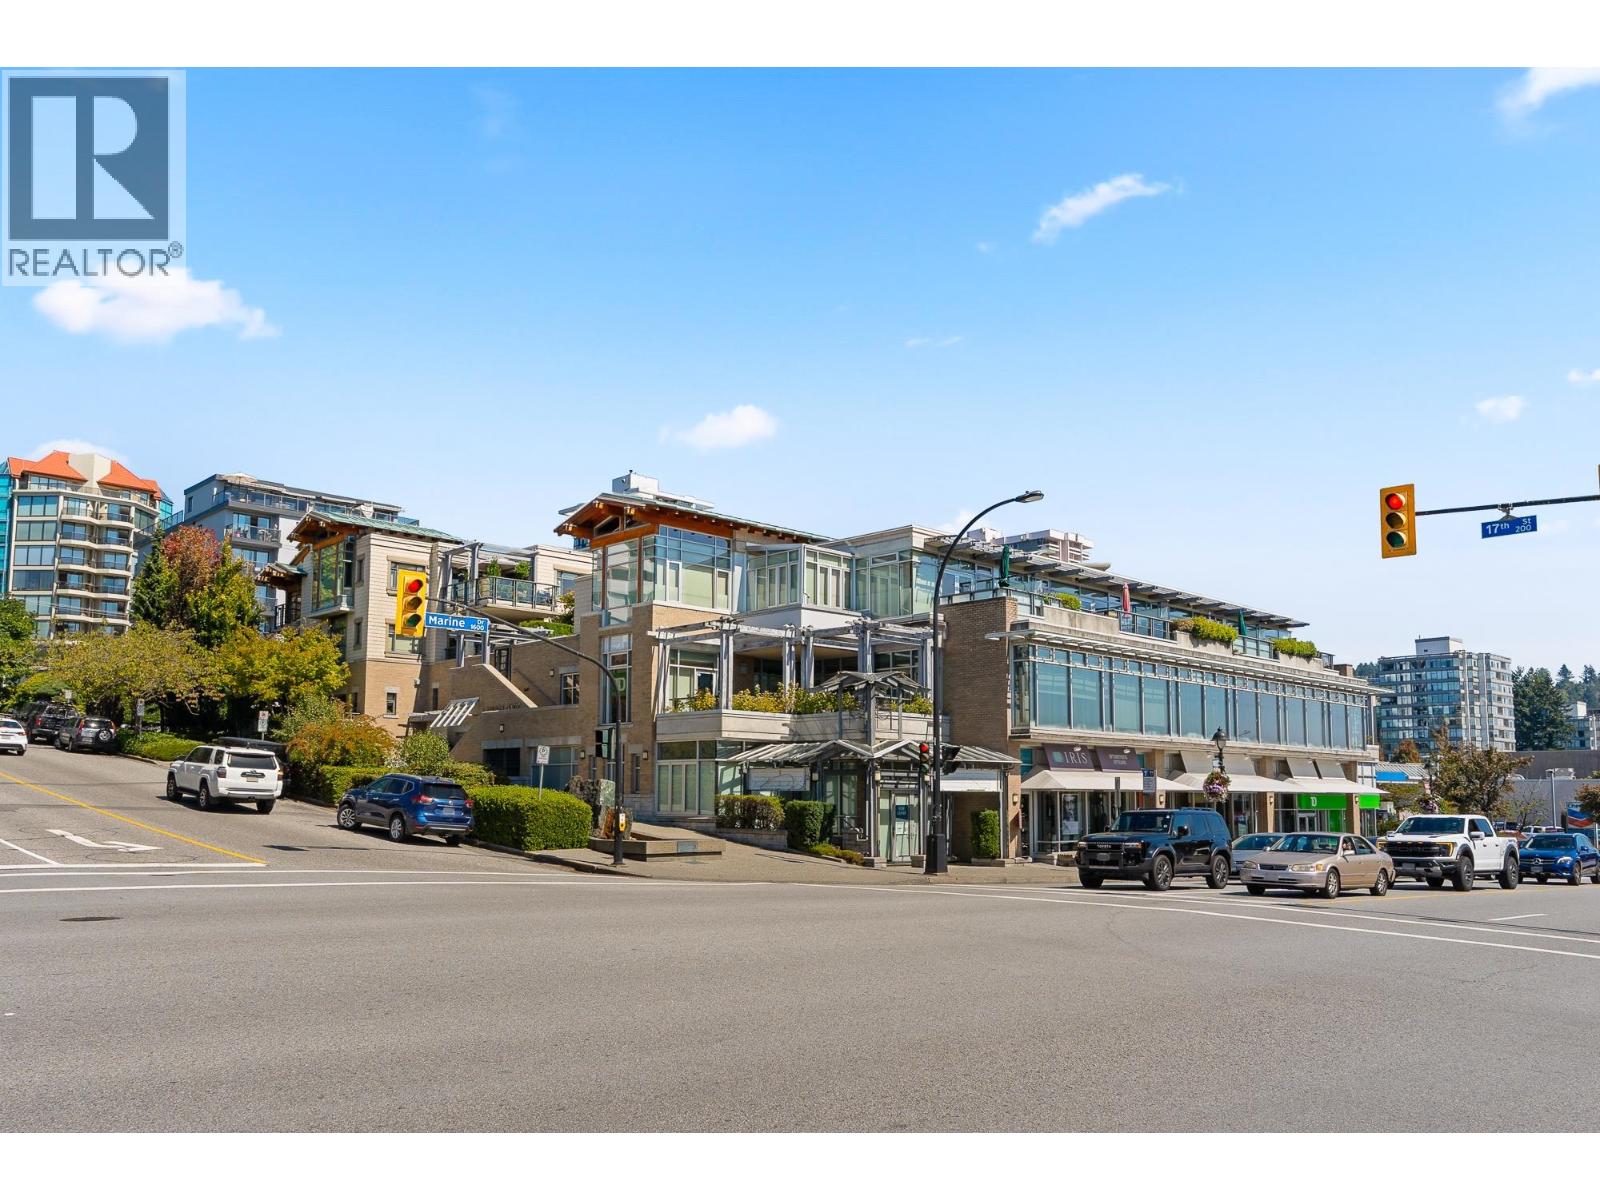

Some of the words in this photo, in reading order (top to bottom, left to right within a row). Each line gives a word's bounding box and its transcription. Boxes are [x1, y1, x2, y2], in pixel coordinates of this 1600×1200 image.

[1486, 523, 1510, 535] 17th
[1515, 524, 1532, 533] 200
[429, 616, 465, 627] Marine
[1063, 751, 1088, 764] IRIS
